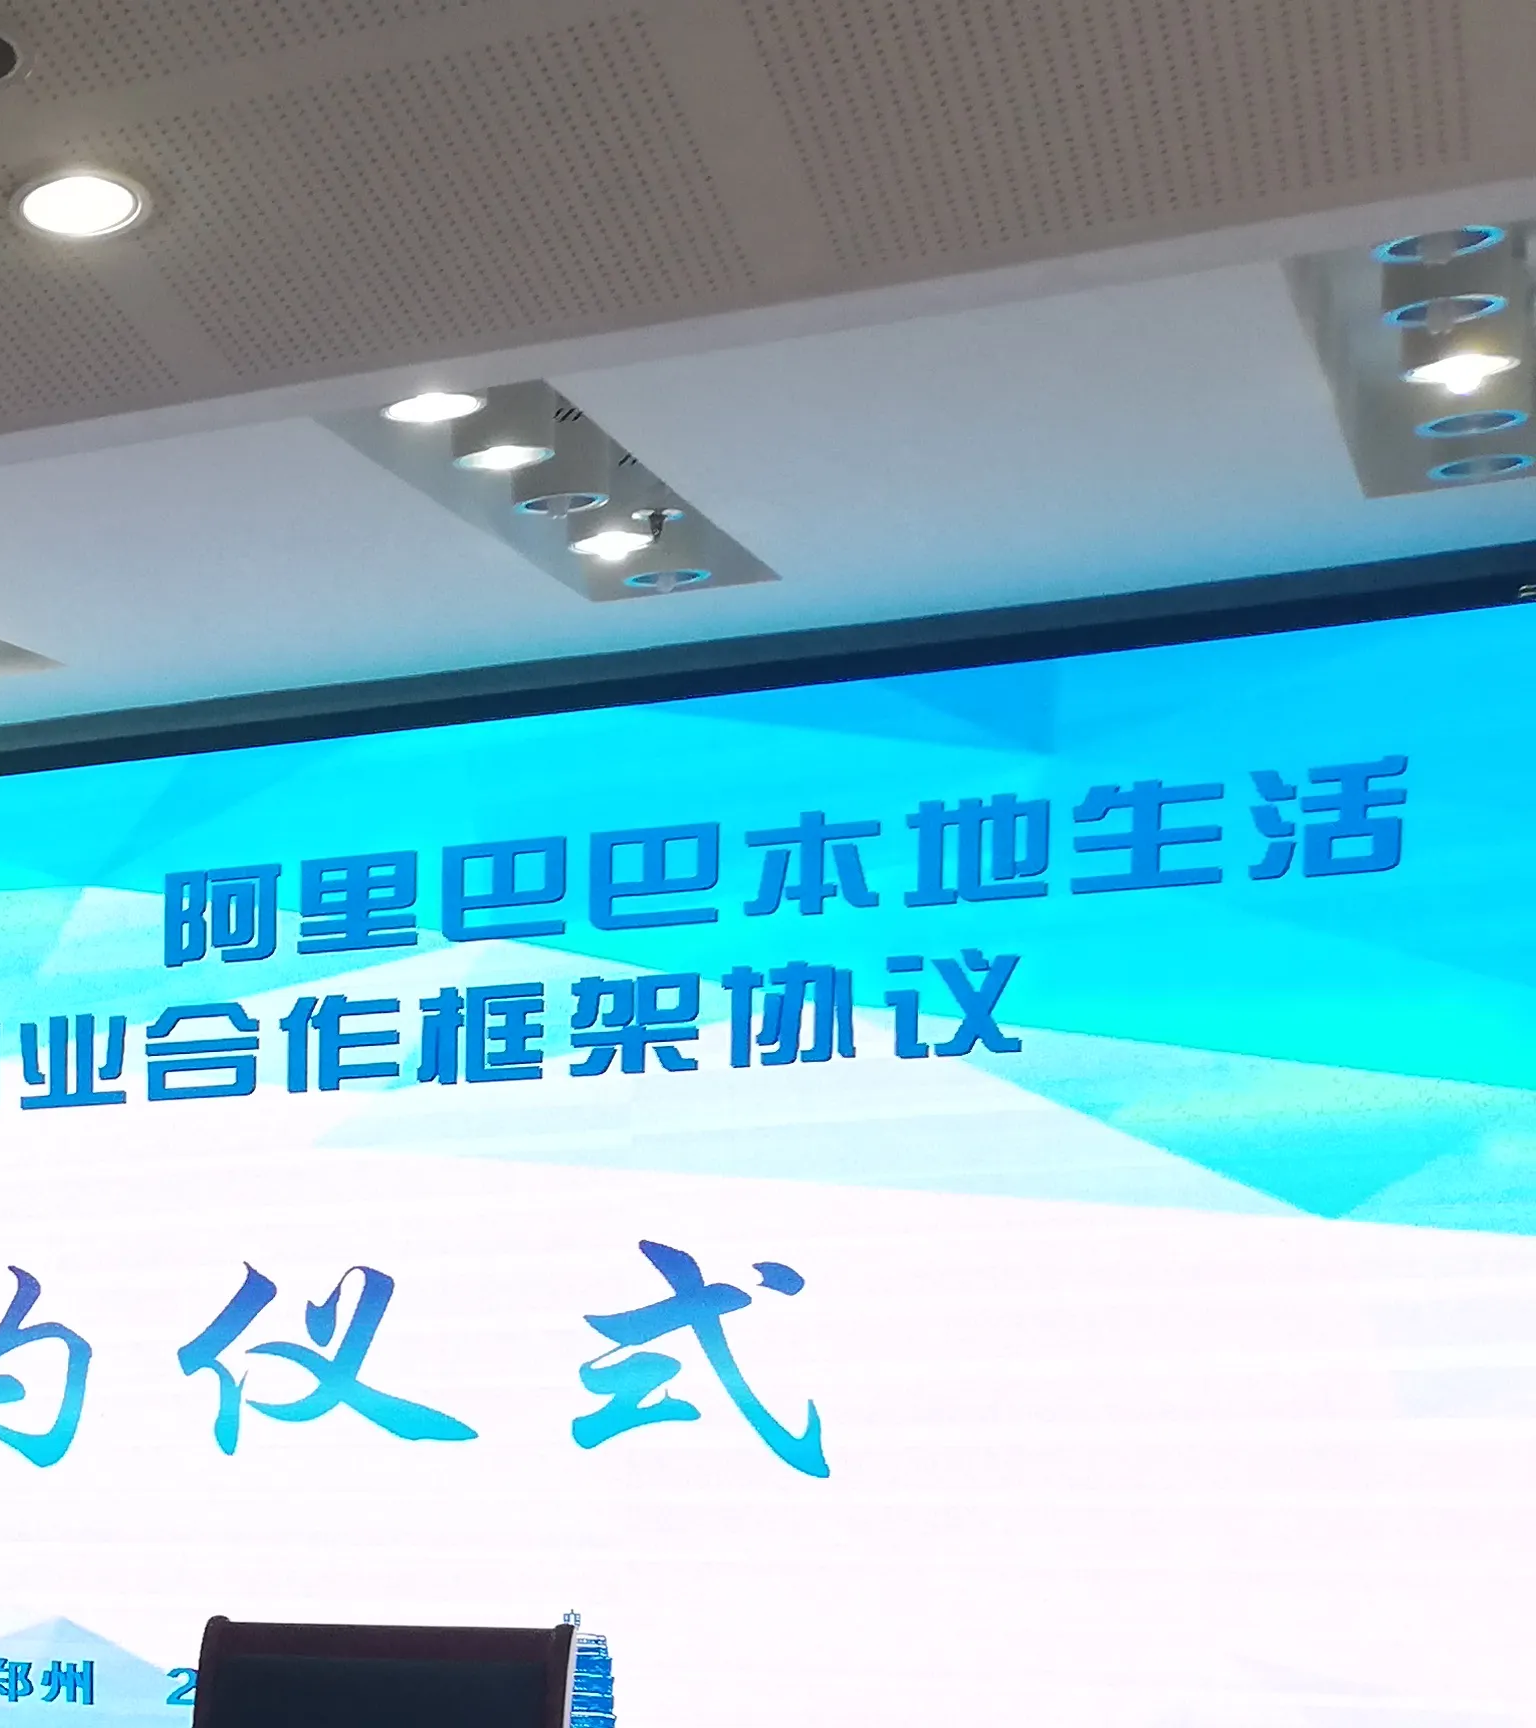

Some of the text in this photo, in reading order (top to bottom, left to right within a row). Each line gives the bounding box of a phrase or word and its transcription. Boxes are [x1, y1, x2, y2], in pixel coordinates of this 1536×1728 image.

[163, 754, 1410, 968] 阿里巴巴本地生活
